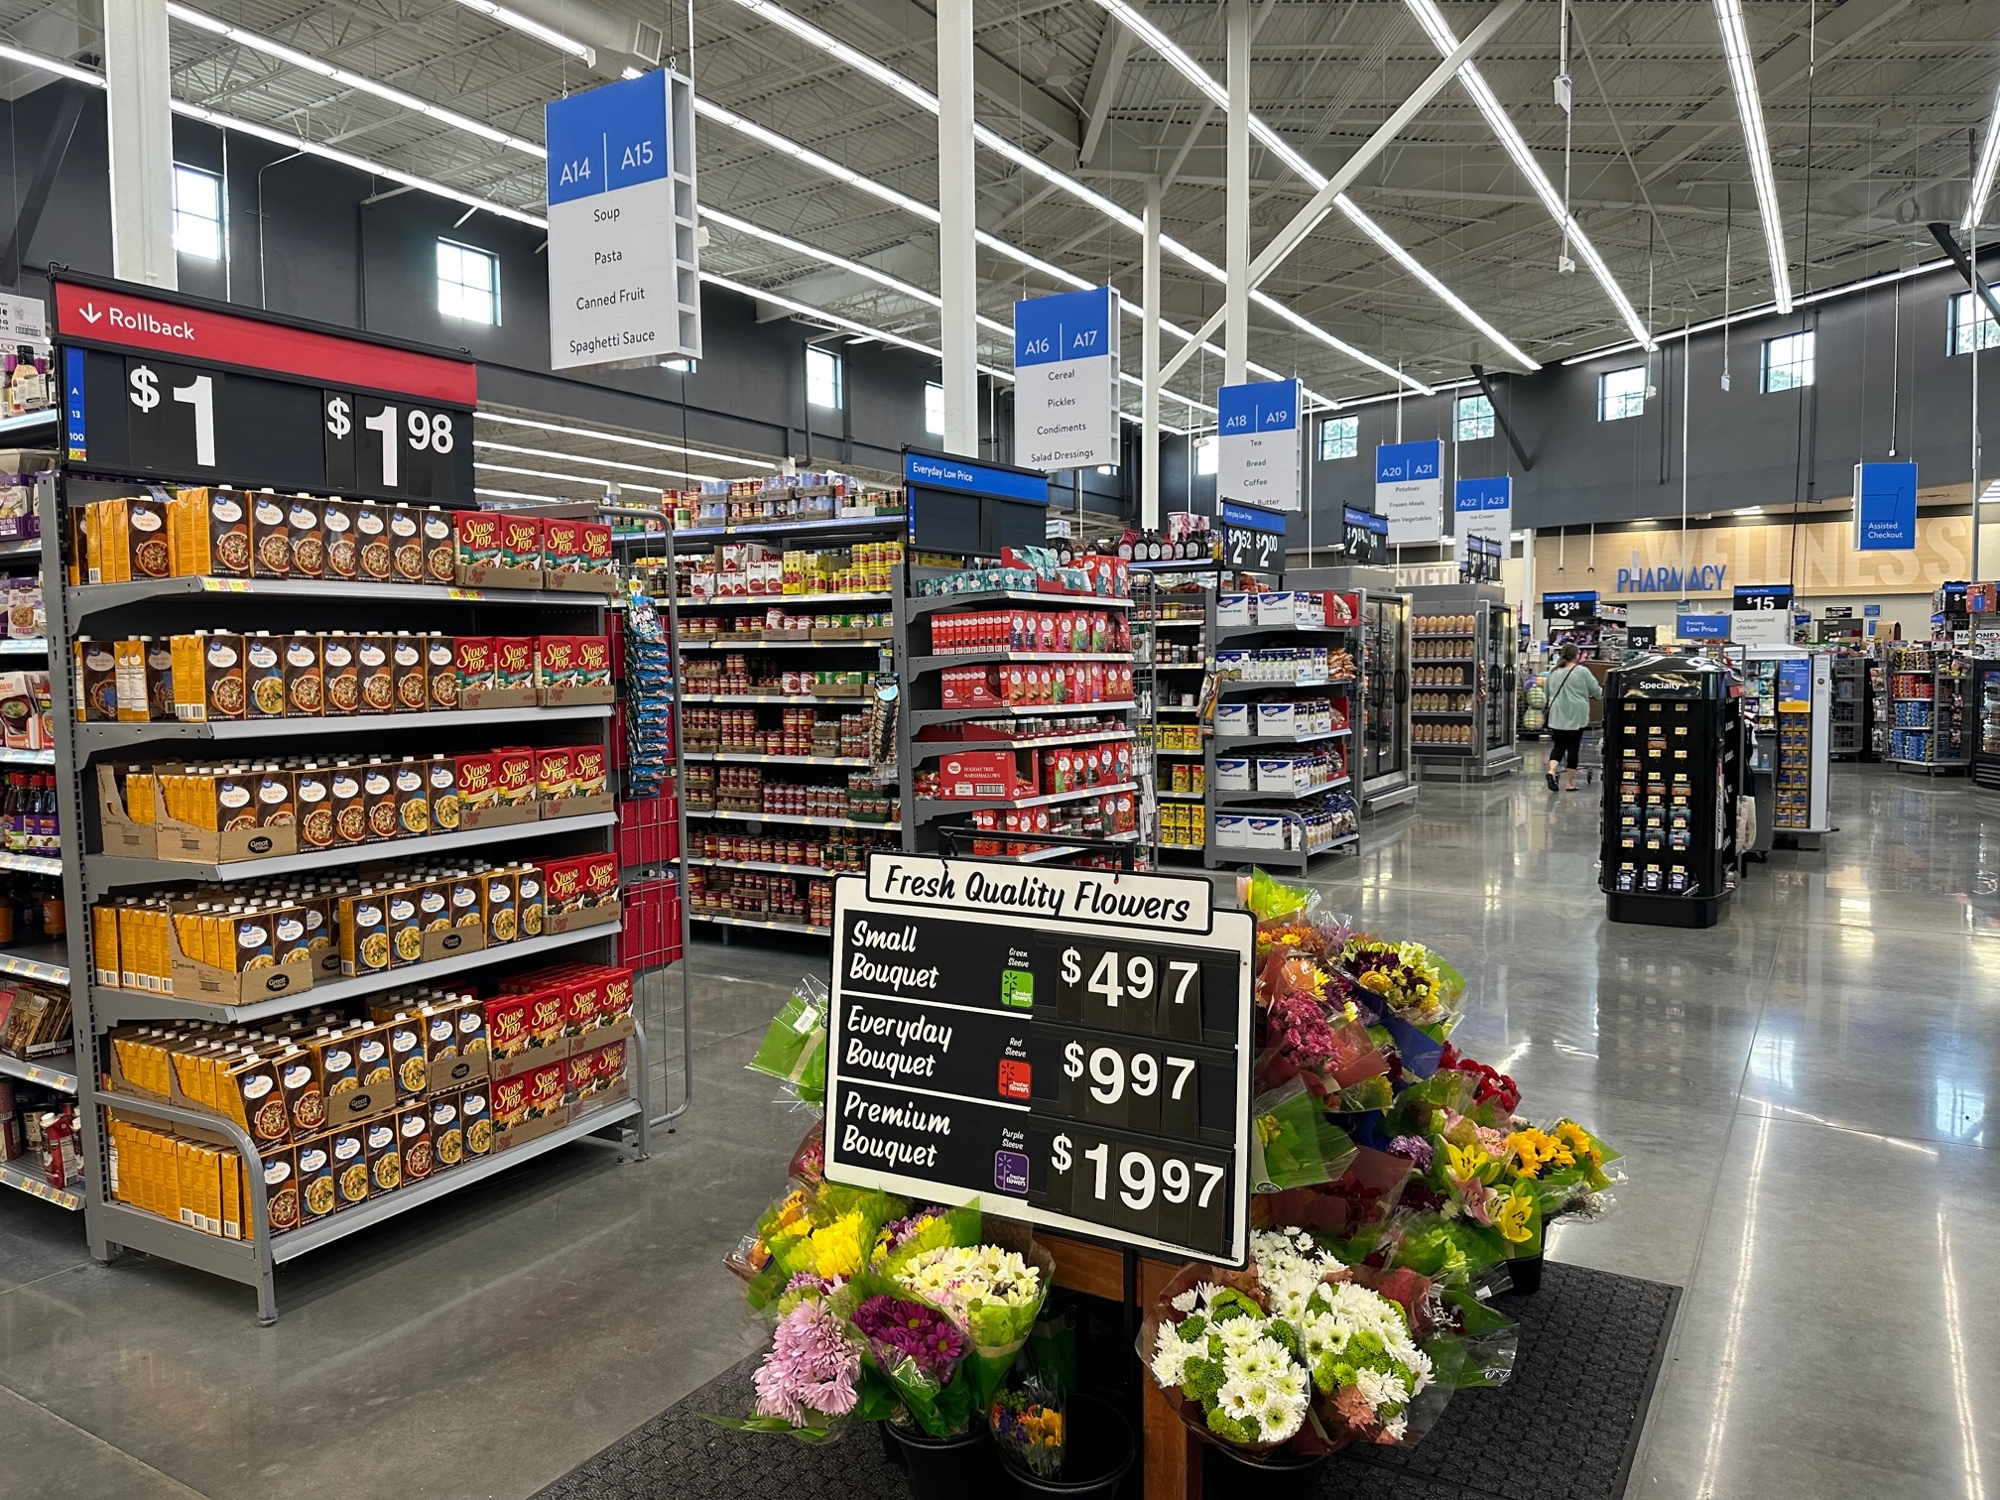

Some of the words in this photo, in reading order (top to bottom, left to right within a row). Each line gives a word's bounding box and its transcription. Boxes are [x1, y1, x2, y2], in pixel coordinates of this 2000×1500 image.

[560, 158, 591, 186] A14
[621, 140, 654, 170] A15
[594, 207, 620, 223] Soup
[594, 251, 623, 265] Pasta
[576, 292, 616, 310] Canned
[620, 287, 645, 302] Fruit
[109, 308, 195, 341] Rollback
[570, 333, 620, 354] Spaghetti
[623, 330, 655, 345] Sauce
[1025, 338, 1050, 355] A16
[1073, 330, 1098, 348] A17
[1048, 370, 1075, 381] Cereal
[72, 387, 79, 396] A
[1048, 398, 1076, 408] Pickles
[72, 410, 81, 418] 13
[1226, 415, 1247, 428] A18
[1266, 411, 1287, 424] A19
[70, 432, 85, 442] 100
[1037, 423, 1086, 436] Condiments
[1031, 452, 1052, 463] Salad
[1054, 450, 1094, 461] Dressings
[1246, 460, 1266, 468] Bread
[913, 462, 943, 479] Everyday
[944, 468, 956, 479] Low
[958, 470, 973, 482] Price
[1382, 467, 1402, 477] A20
[1415, 464, 1433, 474] A21
[1244, 479, 1268, 487] Coffee
[1487, 497, 1504, 505] A23
[1226, 509, 1239, 520] Everyday
[463, 520, 495, 543] Stove
[1869, 522, 1898, 530] Assisted
[475, 534, 491, 549] Top
[506, 524, 536, 546] Stove
[548, 527, 575, 549] Stove
[582, 530, 608, 552] Stove
[1868, 531, 1903, 539] Checkout
[518, 539, 532, 552] Top
[558, 542, 572, 555] Top
[592, 545, 605, 557] Top
[1617, 565, 1727, 593] PHARMACY
[457, 645, 488, 668] Stove
[500, 645, 529, 668] Stove
[544, 644, 572, 666] Stove
[578, 644, 606, 666] Stove
[469, 660, 485, 673] Top
[511, 660, 525, 672] Top
[555, 659, 569, 671] Top
[588, 658, 602, 671] Top
[1640, 682, 1681, 691] Specialty
[499, 760, 530, 784] Stove
[540, 756, 569, 779] Stove
[575, 753, 601, 776] Stove
[586, 766, 599, 779] Top
[460, 763, 492, 788] Stove
[512, 774, 527, 788] Top
[552, 770, 566, 783] Top
[472, 778, 488, 791] Top
[251, 840, 269, 848] Great
[550, 869, 579, 894] Stove
[586, 863, 614, 887] Stove
[597, 875, 610, 890] Top
[561, 882, 576, 898] Top
[884, 865, 955, 899] Fresh
[965, 872, 1065, 917] Quality
[1074, 881, 1190, 923] Flowers
[851, 921, 918, 953] Small
[1009, 947, 1028, 958] Green
[1008, 958, 1029, 968] Sleeve
[850, 953, 939, 990] Bouquet
[269, 978, 286, 986] Great
[603, 979, 629, 1006] Stove
[613, 992, 626, 1008] Top
[1012, 994, 1032, 1002] flowers
[569, 988, 597, 1016] Stove
[532, 998, 561, 1025] Stove
[580, 1003, 595, 1020] Top
[494, 1008, 524, 1037] Stove
[543, 1012, 558, 1031] Top
[504, 1024, 521, 1042] Top
[848, 1006, 952, 1054] Everyday
[1010, 1037, 1023, 1047] Red
[846, 1039, 935, 1077] Bouquet
[1005, 1047, 1026, 1058] Sleeve
[532, 1067, 561, 1097] Stove
[1009, 1084, 1029, 1093] flowers
[494, 1080, 524, 1110] Stove
[543, 1084, 558, 1102] Top
[504, 1096, 521, 1115] Top
[844, 1092, 951, 1136] Premium
[1002, 1128, 1024, 1140] Purple
[842, 1125, 937, 1167] Bouquet
[1002, 1139, 1024, 1150] Sleeve
[1006, 1177, 1026, 1186] flowers
